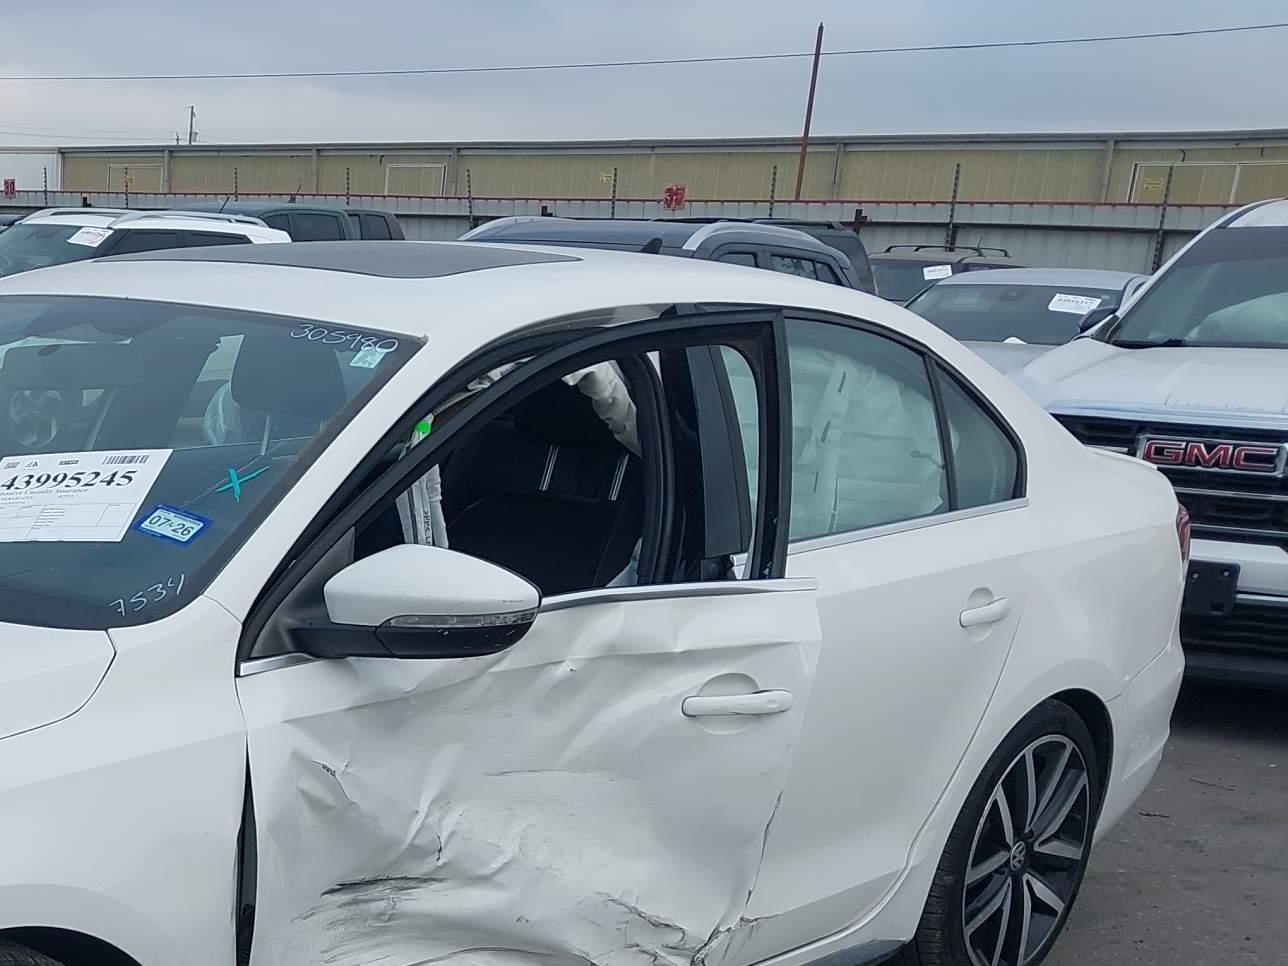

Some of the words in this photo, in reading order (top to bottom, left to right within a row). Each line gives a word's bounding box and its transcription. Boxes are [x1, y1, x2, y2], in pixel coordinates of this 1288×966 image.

[1143, 438, 1279, 472] GMC
[0, 470, 138, 490] 43995245
[148, 515, 172, 527] 07
[171, 522, 195, 536] 26
